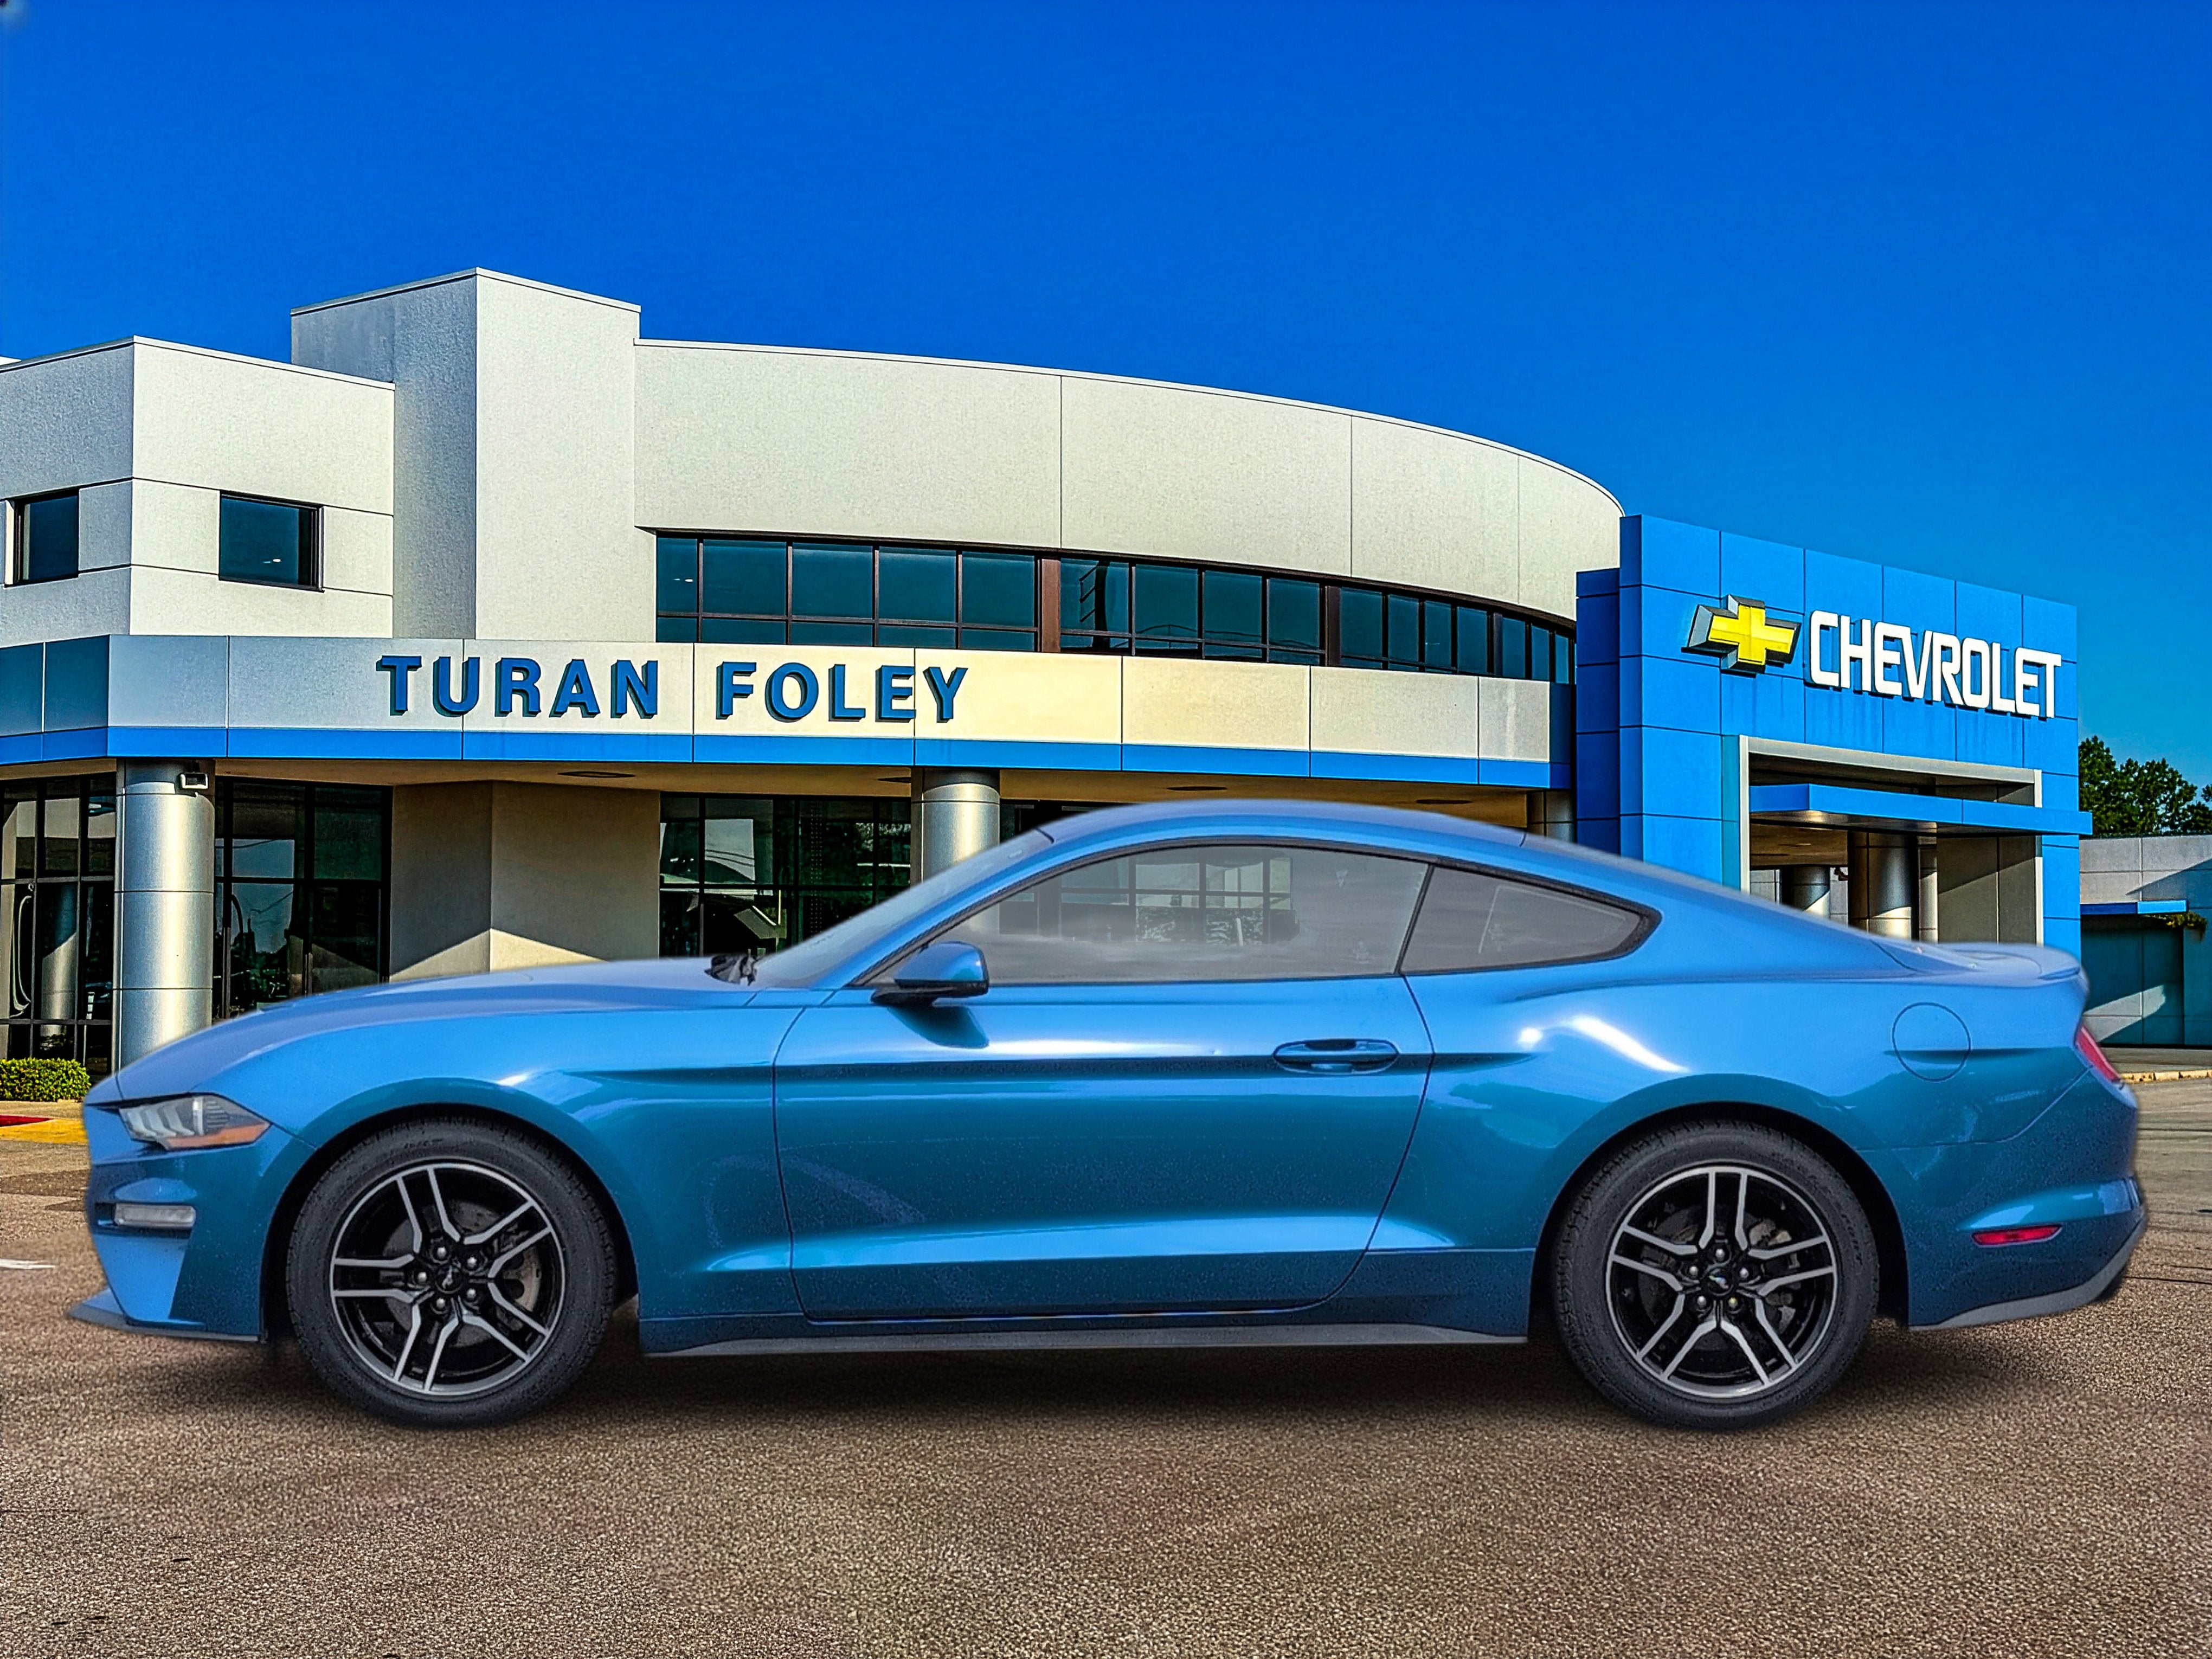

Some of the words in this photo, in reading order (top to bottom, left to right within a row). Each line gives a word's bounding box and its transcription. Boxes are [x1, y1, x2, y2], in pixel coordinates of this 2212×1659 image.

[377, 655, 658, 718] TURAN
[716, 661, 969, 723] FOLEY
[1810, 610, 2062, 718] CHEVROLET
